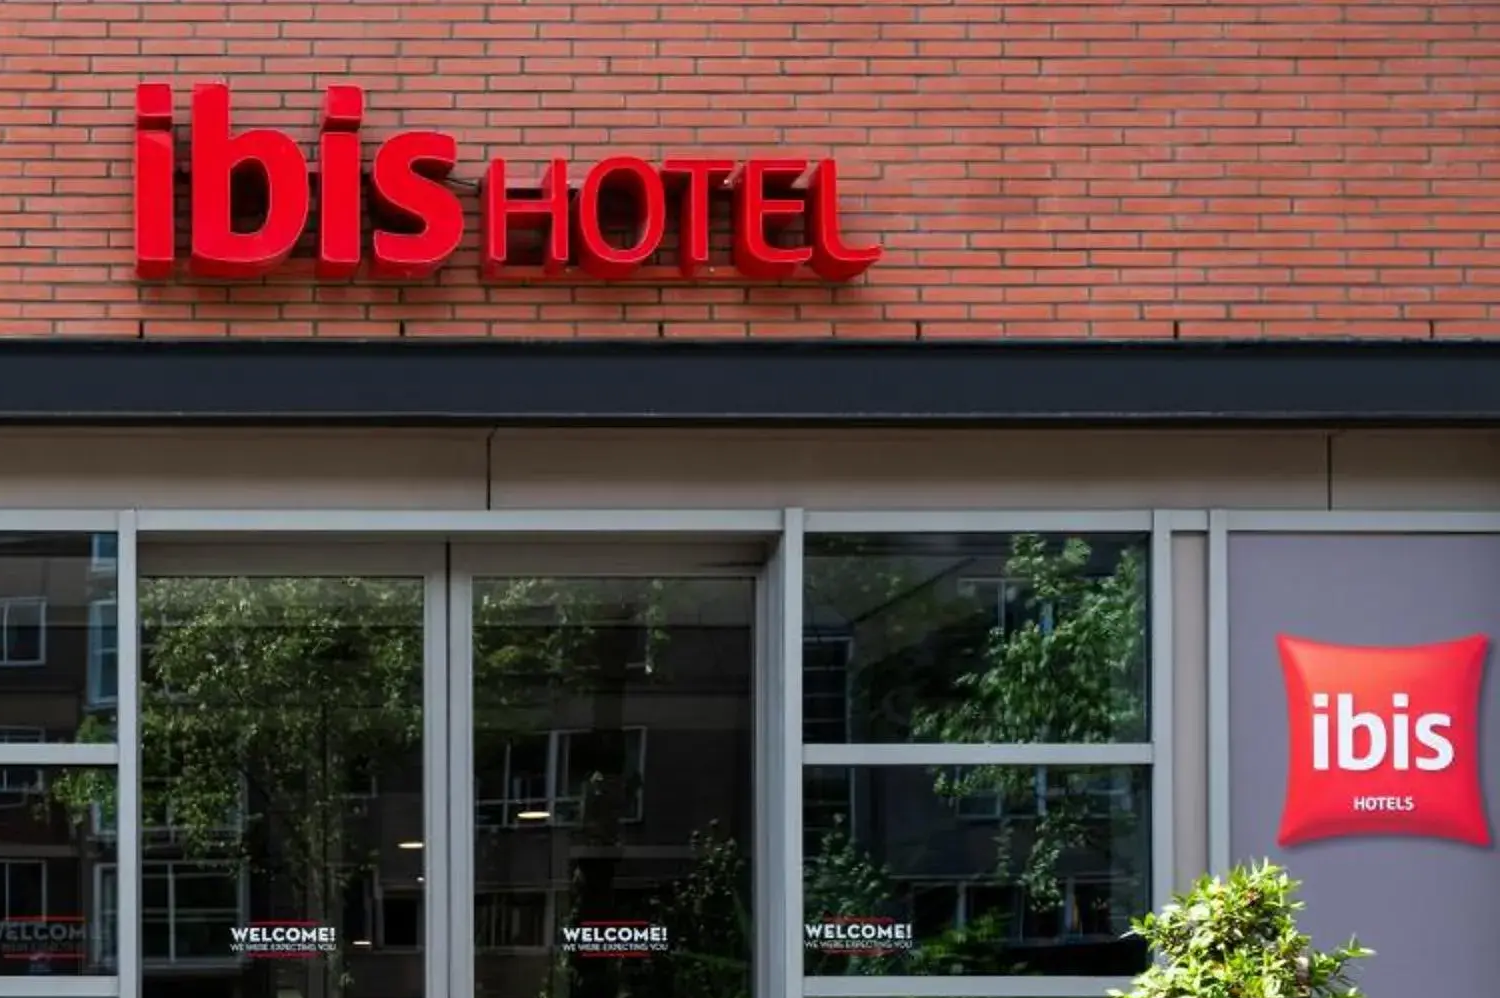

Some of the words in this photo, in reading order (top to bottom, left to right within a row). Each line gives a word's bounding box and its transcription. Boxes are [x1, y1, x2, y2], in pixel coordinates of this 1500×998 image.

[135, 82, 465, 277] ibis
[481, 156, 883, 278] HOTEL
[1312, 692, 1455, 771] ibis
[1353, 795, 1415, 811] HOTELS
[230, 926, 336, 943] WELCOME!
[562, 926, 669, 943] WELCOME!
[804, 923, 913, 940] WELCOME!
